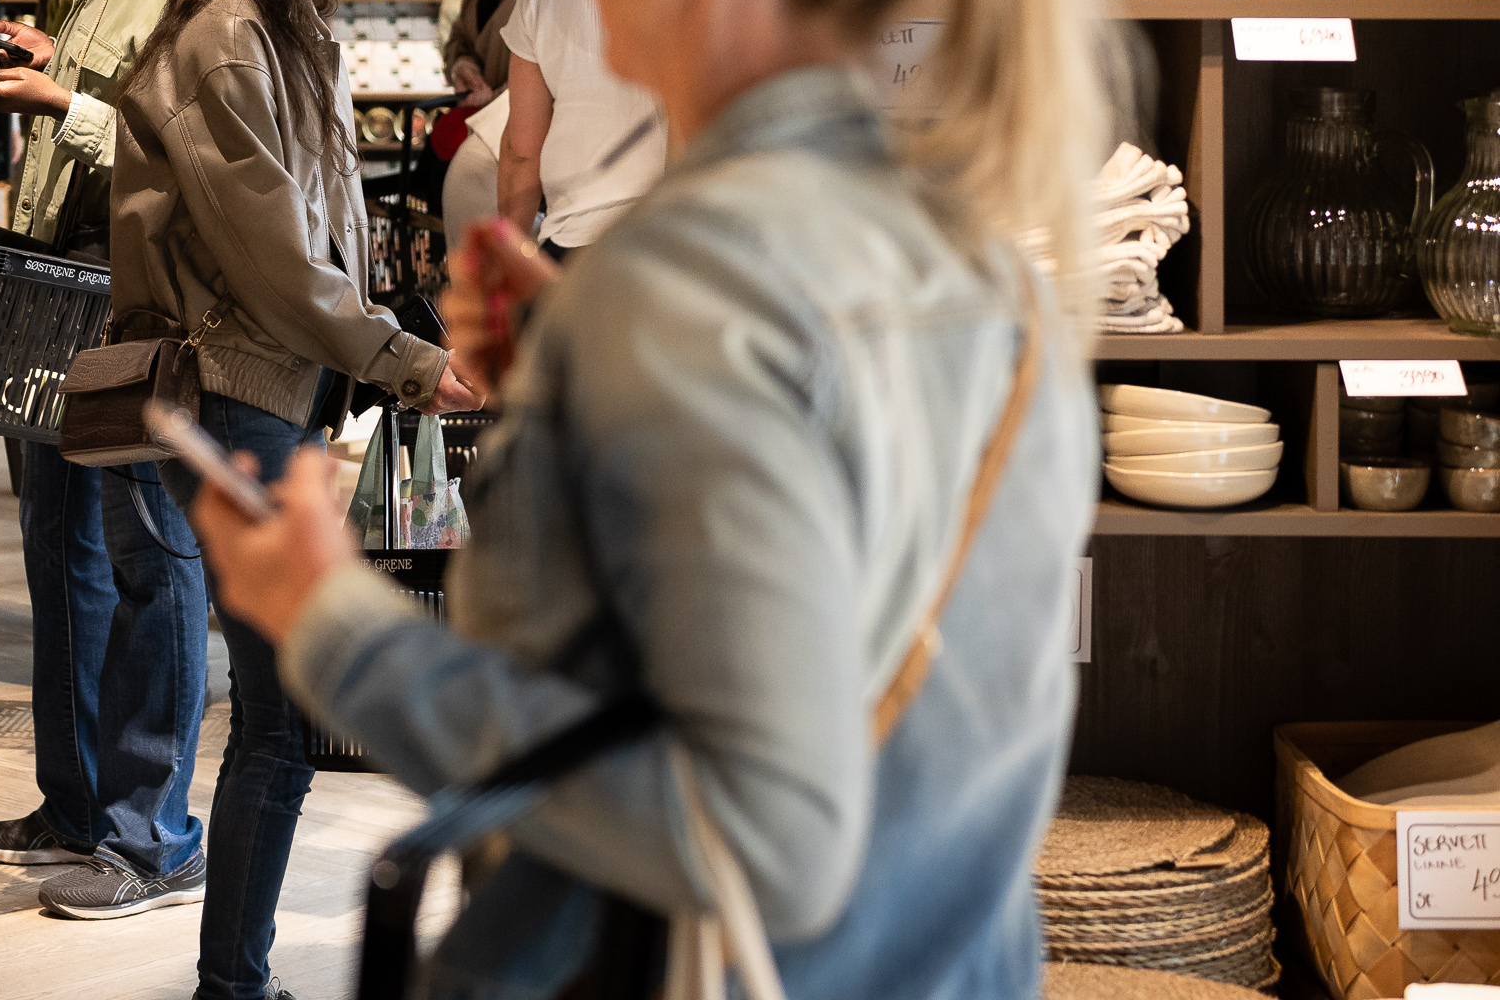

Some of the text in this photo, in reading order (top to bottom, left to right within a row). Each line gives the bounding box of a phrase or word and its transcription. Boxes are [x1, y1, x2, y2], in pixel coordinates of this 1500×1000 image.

[25, 259, 111, 285] SØSTRENE GRENE
[374, 558, 413, 573] GRENE
[1413, 833, 1487, 857] SERVETT
